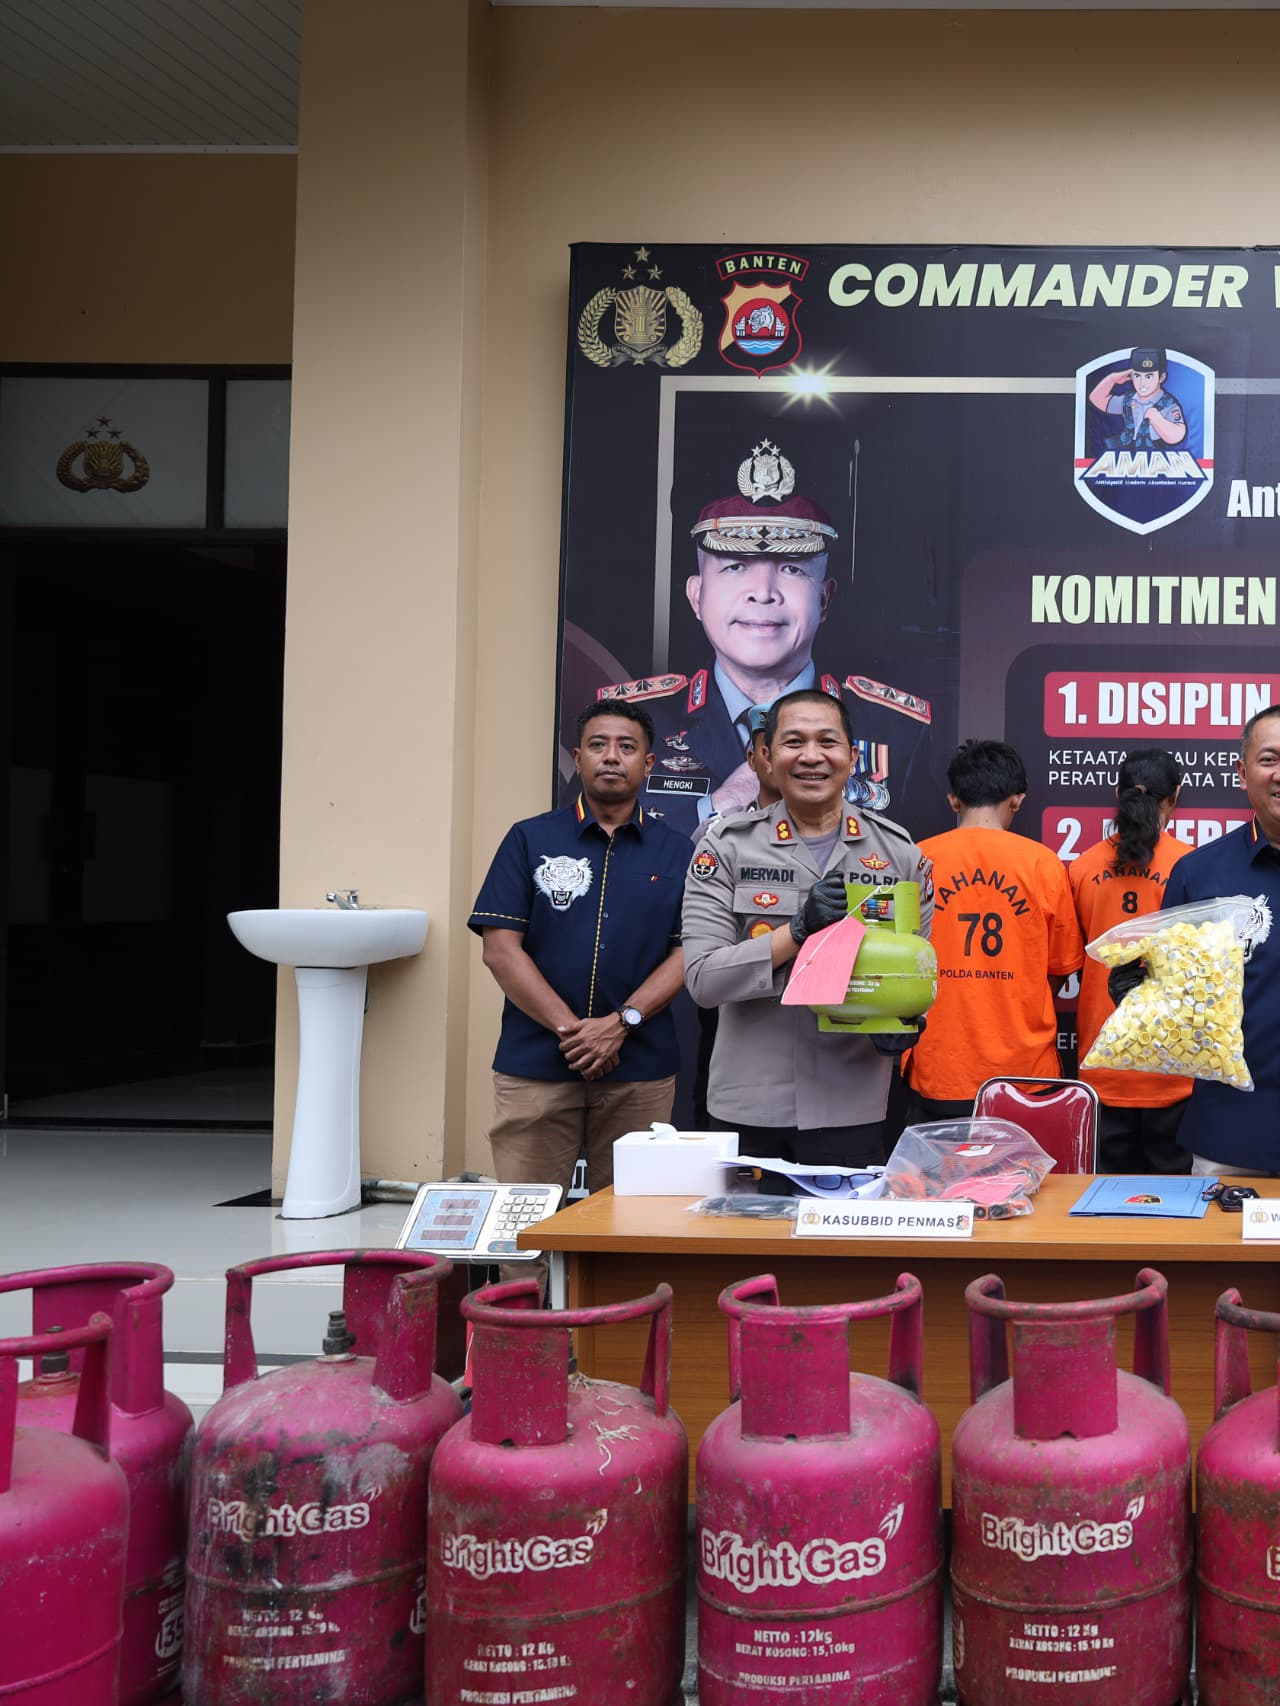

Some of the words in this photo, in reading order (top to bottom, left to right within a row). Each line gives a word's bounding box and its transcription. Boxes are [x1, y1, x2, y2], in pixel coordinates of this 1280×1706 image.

[725, 255, 802, 275] BANTEN
[828, 262, 1249, 309] COMMANDER
[1082, 450, 1206, 479] AMAN
[1031, 574, 1277, 625] KOMITMEN
[1057, 681, 1088, 725] 1.
[1098, 681, 1271, 726] DISIPLIN
[1049, 750, 1128, 765] KETAATA
[663, 779, 693, 790] HENGKI
[1048, 771, 1119, 786] PERATU
[1181, 772, 1215, 787] ATA
[740, 866, 795, 882] MERYADI
[1121, 890, 1138, 914] 8
[957, 912, 1004, 957] 78
[940, 969, 973, 979] POLDA
[975, 970, 1014, 980] BANTEN
[822, 1214, 893, 1227] KASUBBID
[897, 1216, 955, 1229] PENMAS
[982, 1512, 1072, 1562] Bright
[1071, 1519, 1134, 1555] Gas
[523, 1535, 595, 1572] Gas
[701, 1528, 800, 1593] Bright
[800, 1537, 887, 1584] Gas
[753, 1629, 791, 1643] NETTO
[1023, 1623, 1059, 1637] NETTO
[1067, 1624, 1081, 1637] 12
[521, 1643, 535, 1657] 12
[735, 1642, 763, 1657] BERAT
[738, 1671, 786, 1685] PRODUKSI
